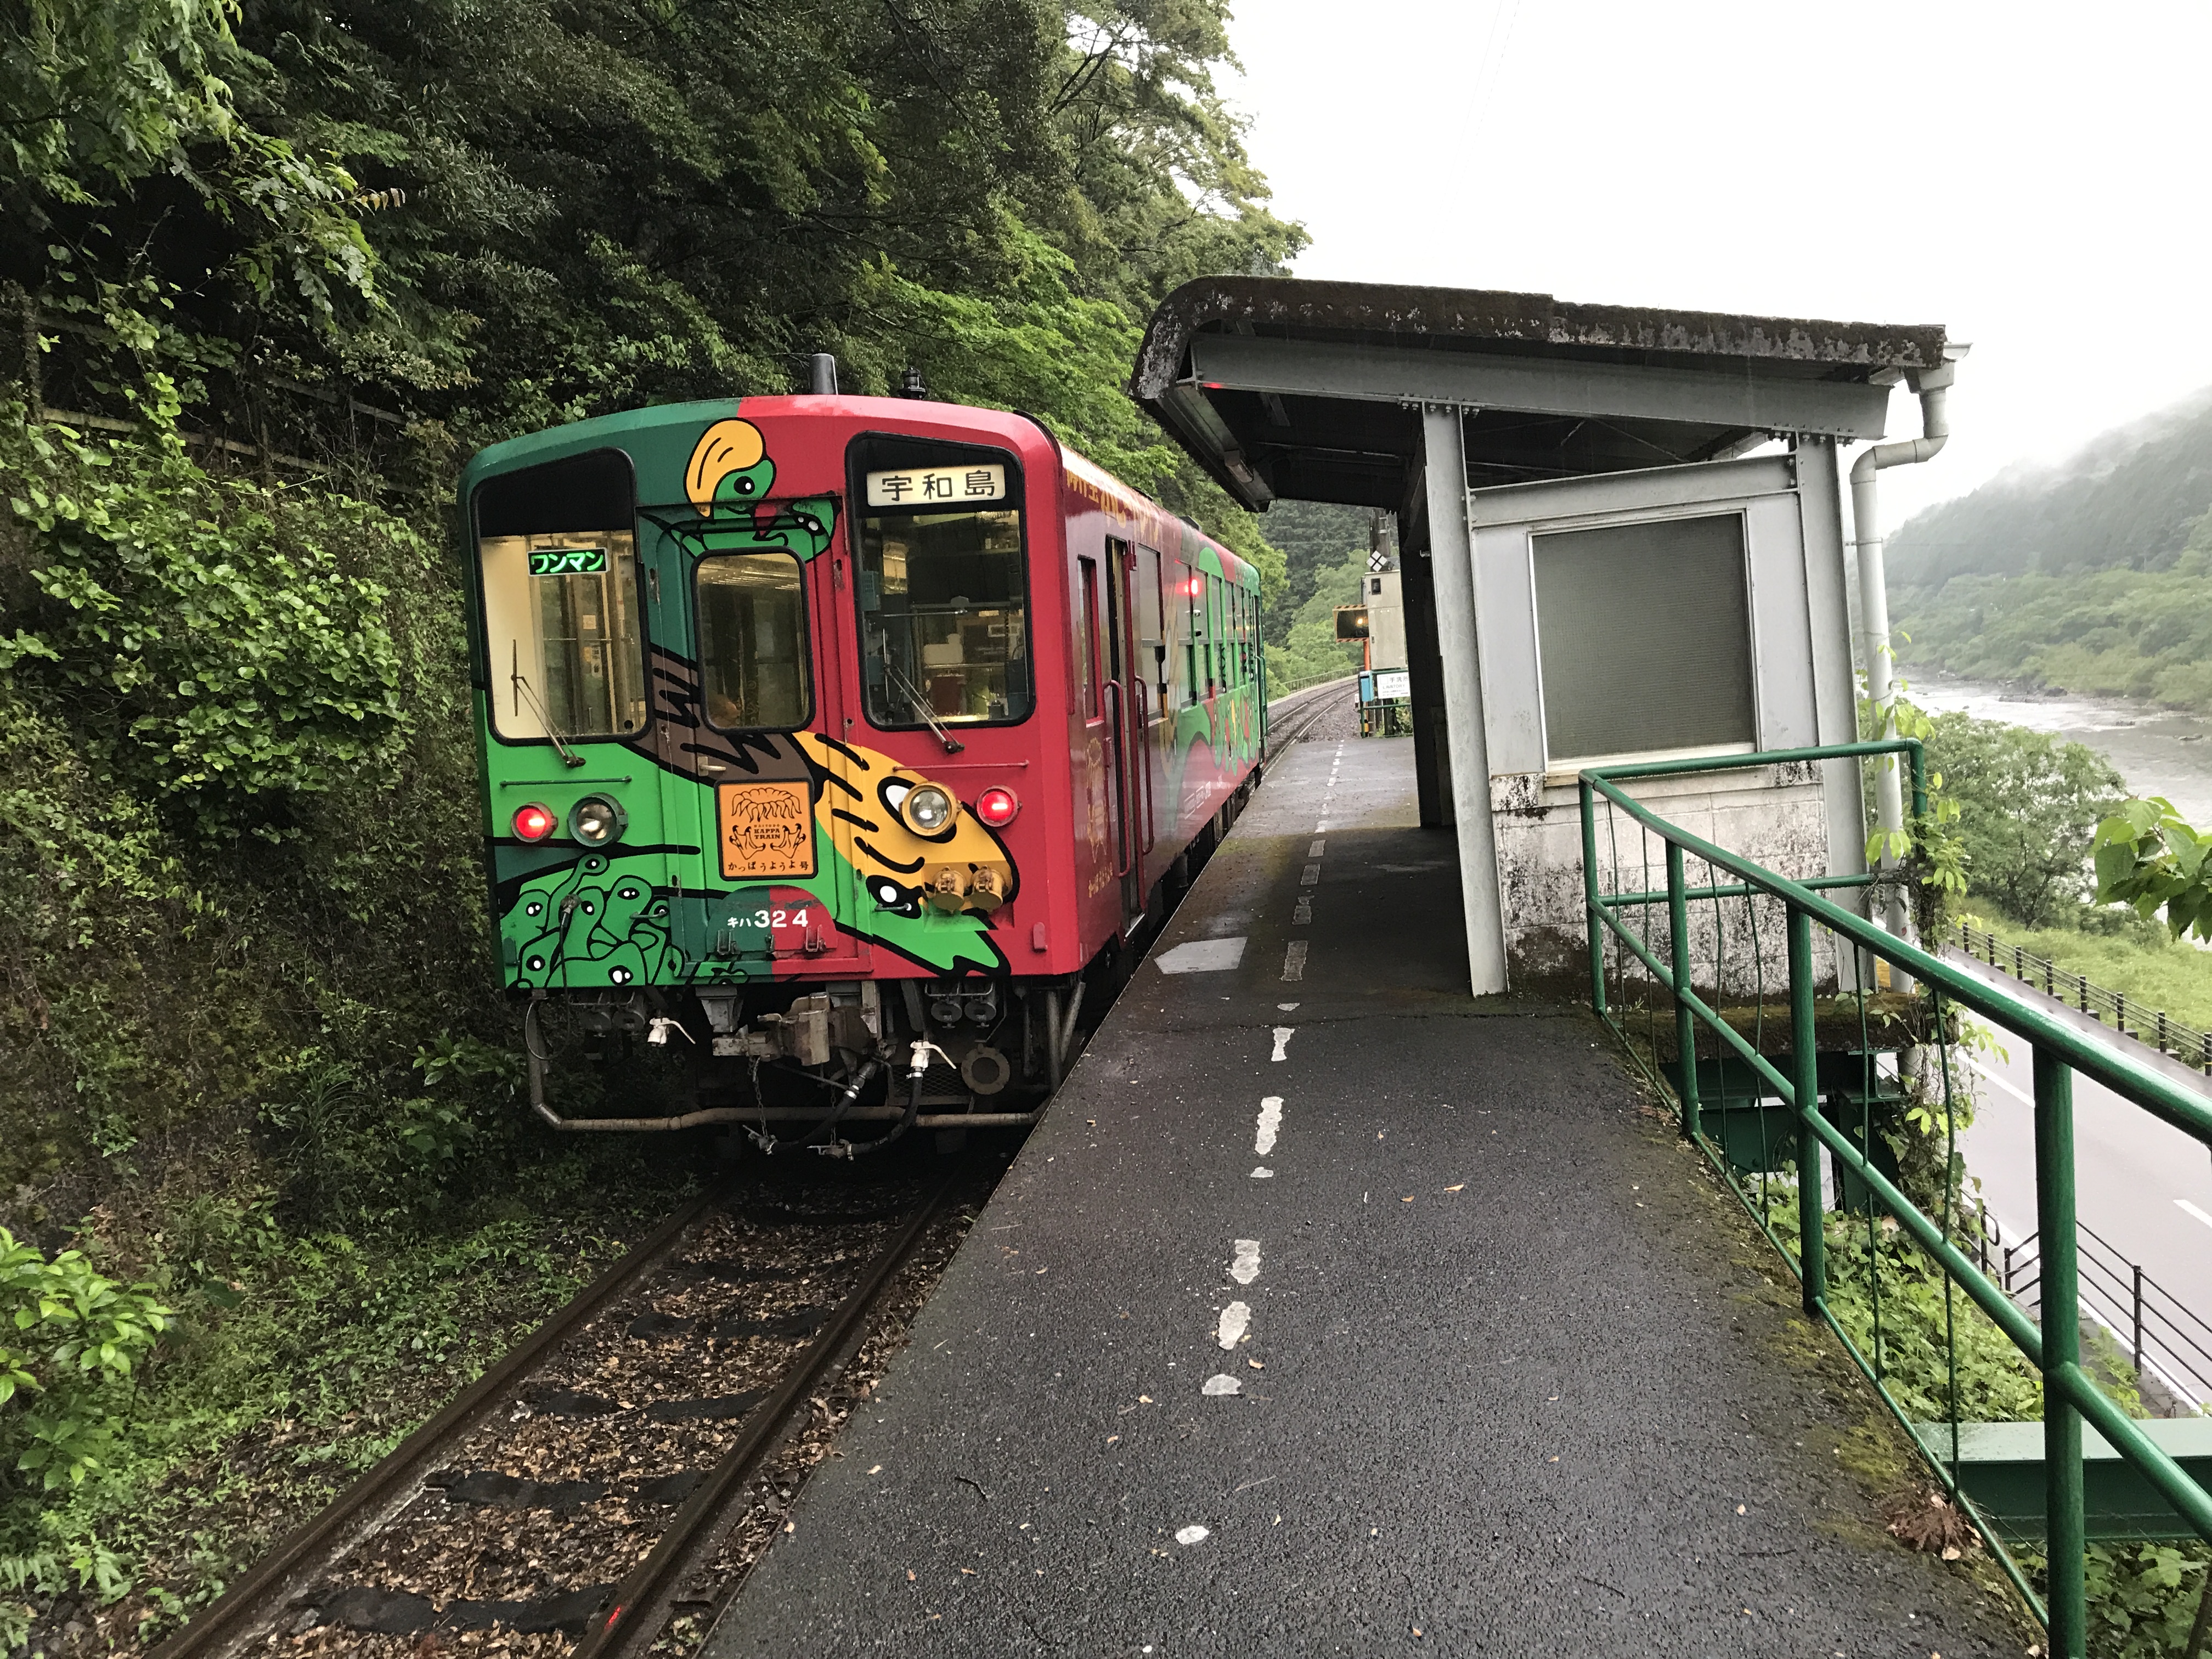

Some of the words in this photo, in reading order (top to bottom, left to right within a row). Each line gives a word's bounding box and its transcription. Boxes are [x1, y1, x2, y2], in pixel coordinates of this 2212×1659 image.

[882, 470, 995, 501] 宇和島
[531, 551, 603, 573] ワンマン
